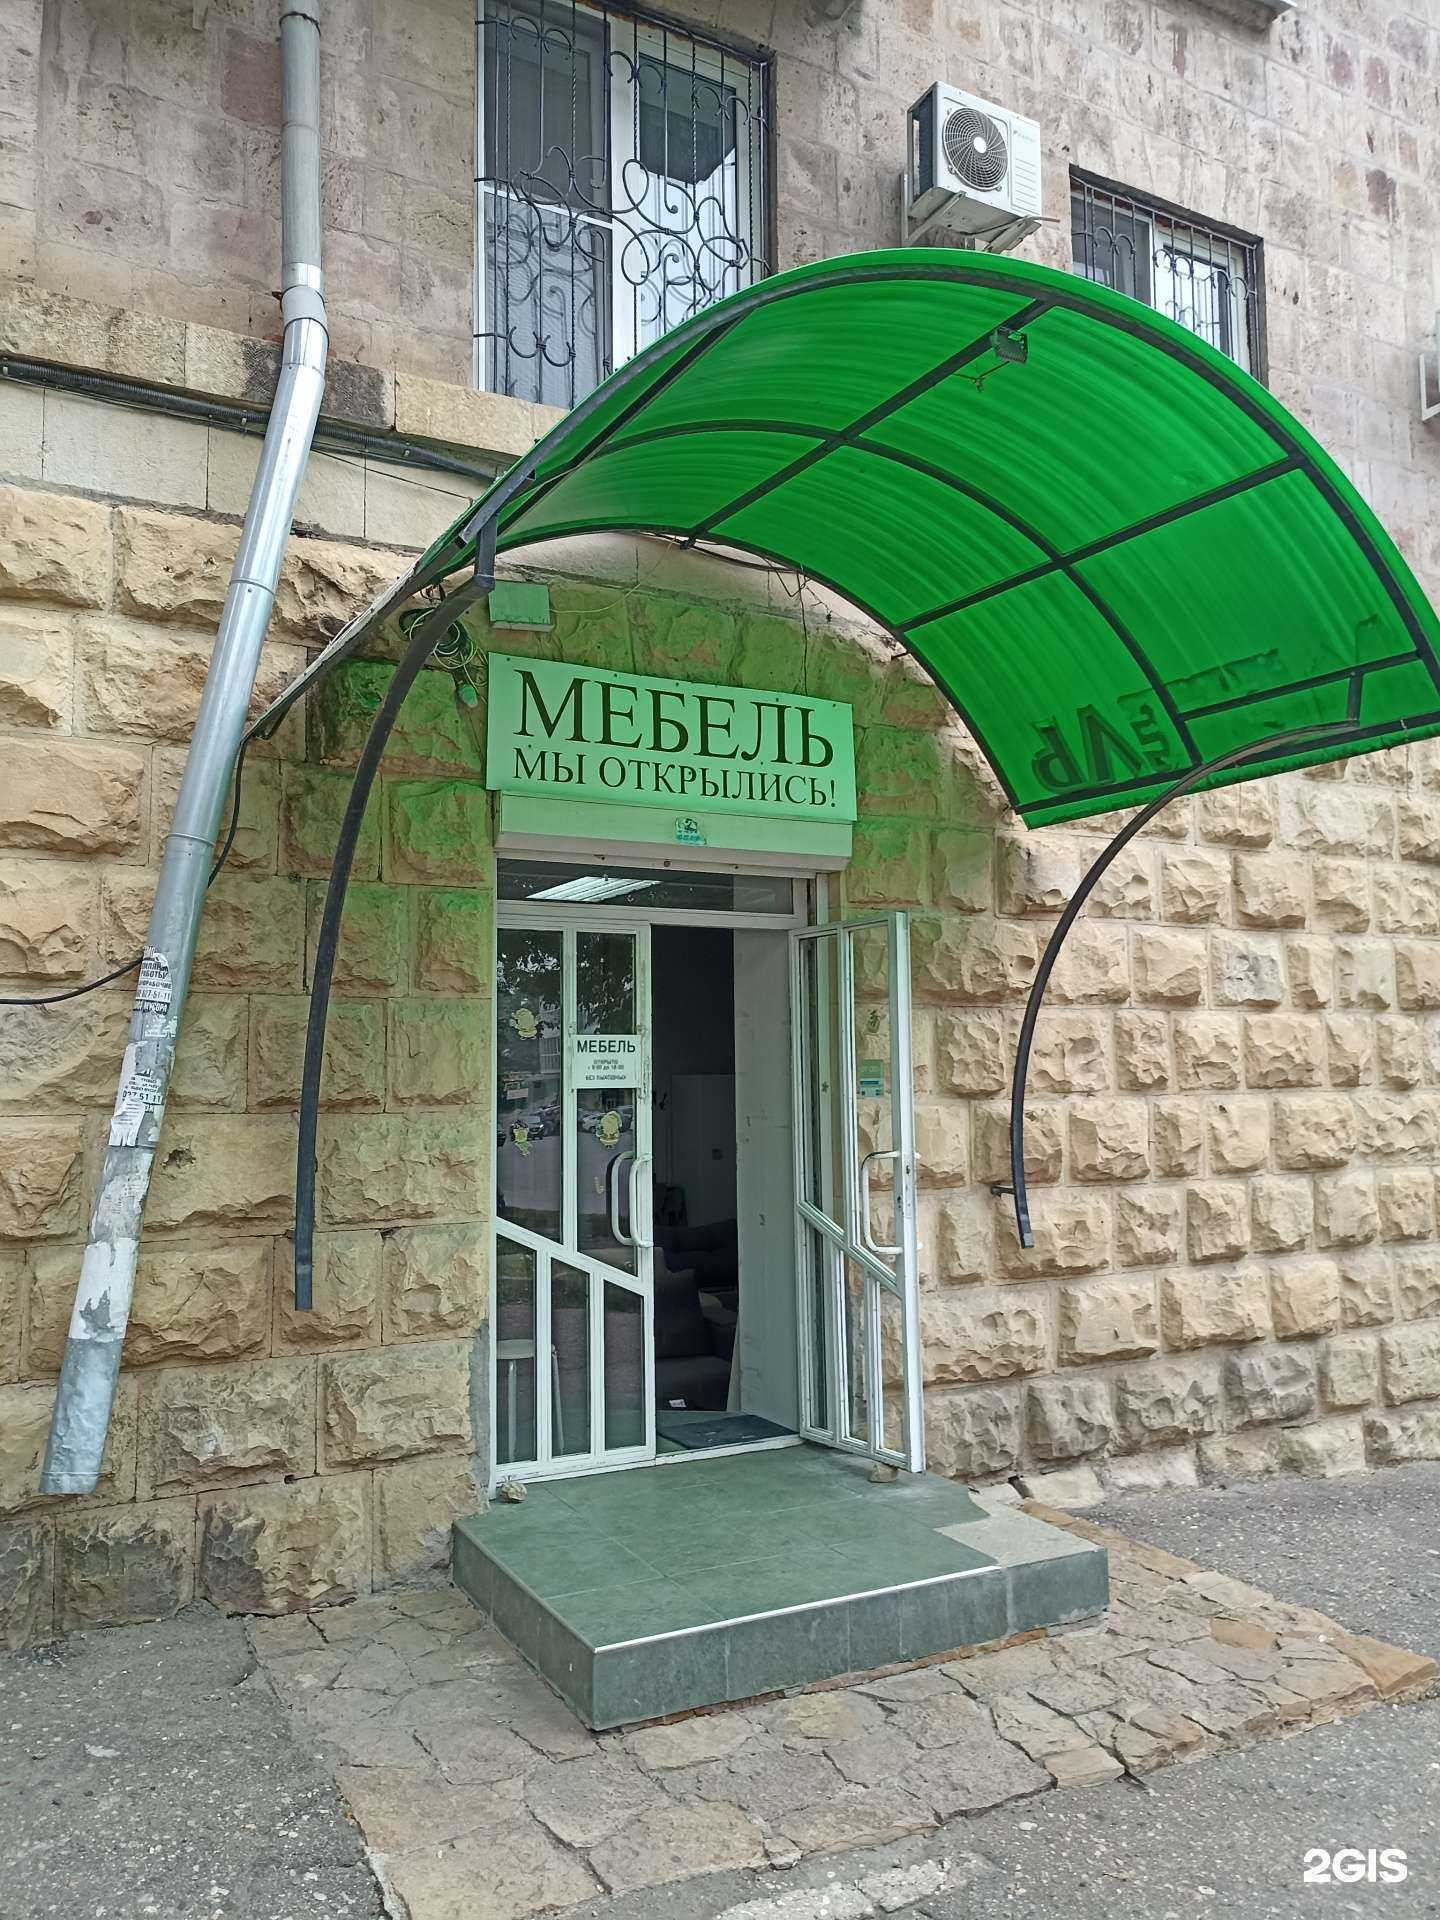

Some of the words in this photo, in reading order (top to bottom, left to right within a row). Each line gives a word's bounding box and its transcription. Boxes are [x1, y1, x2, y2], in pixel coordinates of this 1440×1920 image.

[513, 669, 835, 769] МЕБЕЛЬ
[512, 747, 587, 785] МЫ
[599, 756, 836, 808] ОТКРЫЛИСЬ!
[577, 1039, 636, 1053] МЕБЕЛЬ
